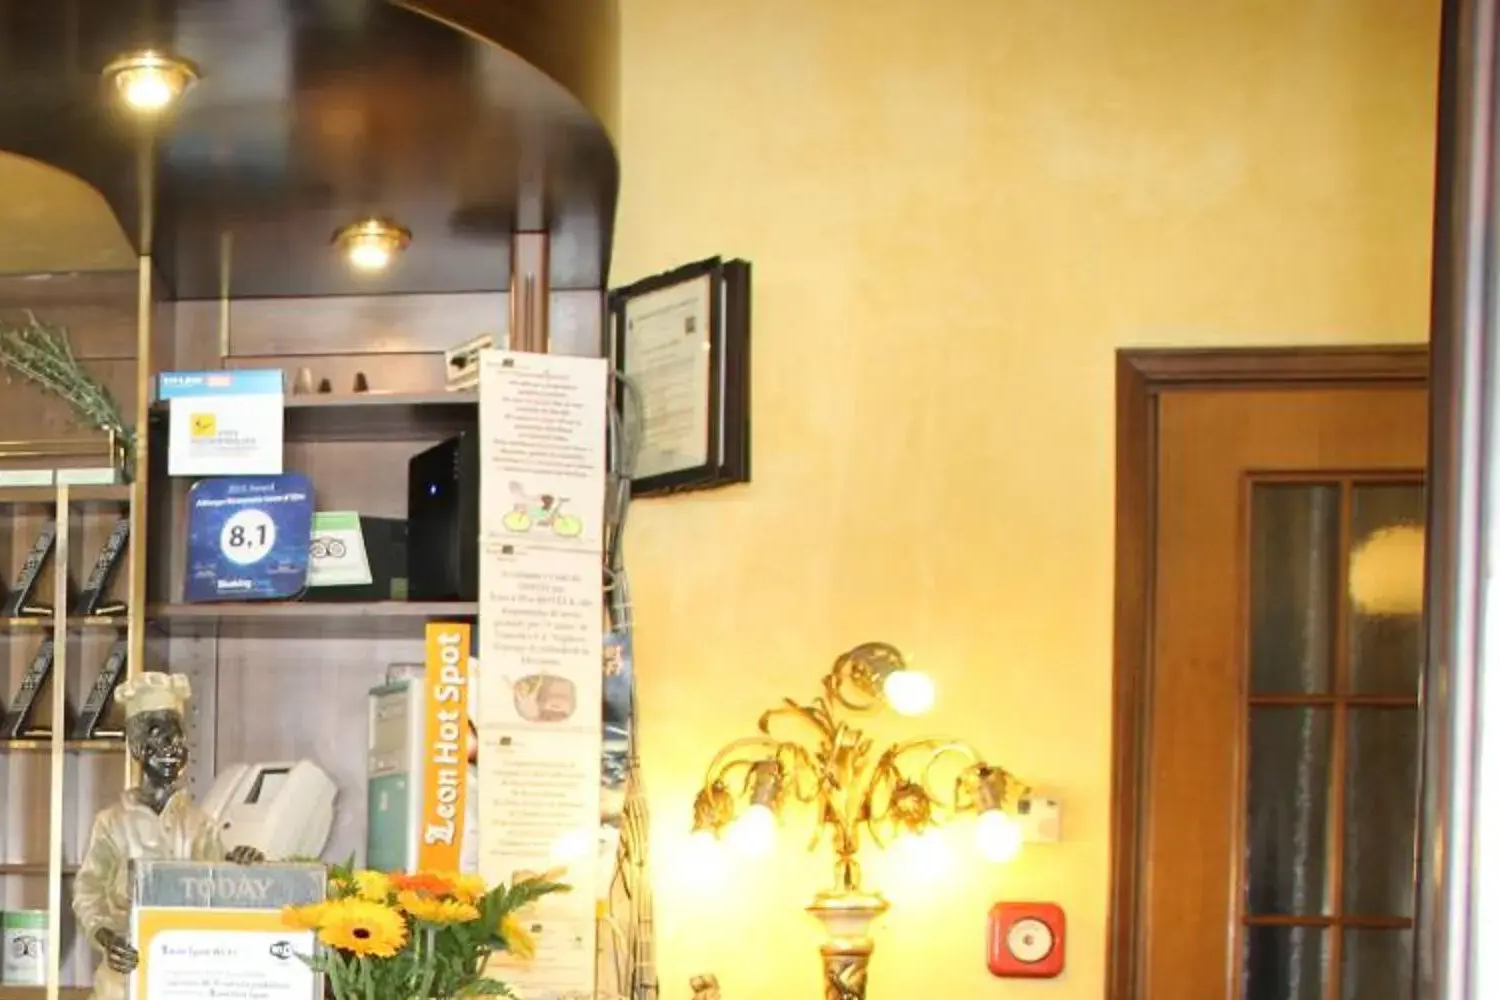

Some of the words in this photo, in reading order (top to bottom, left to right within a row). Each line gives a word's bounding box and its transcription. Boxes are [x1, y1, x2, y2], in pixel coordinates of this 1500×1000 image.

[433, 632, 465, 703] Spot
[432, 710, 459, 764] Hot
[424, 769, 457, 845] Leon
[178, 874, 275, 900] TODAY
